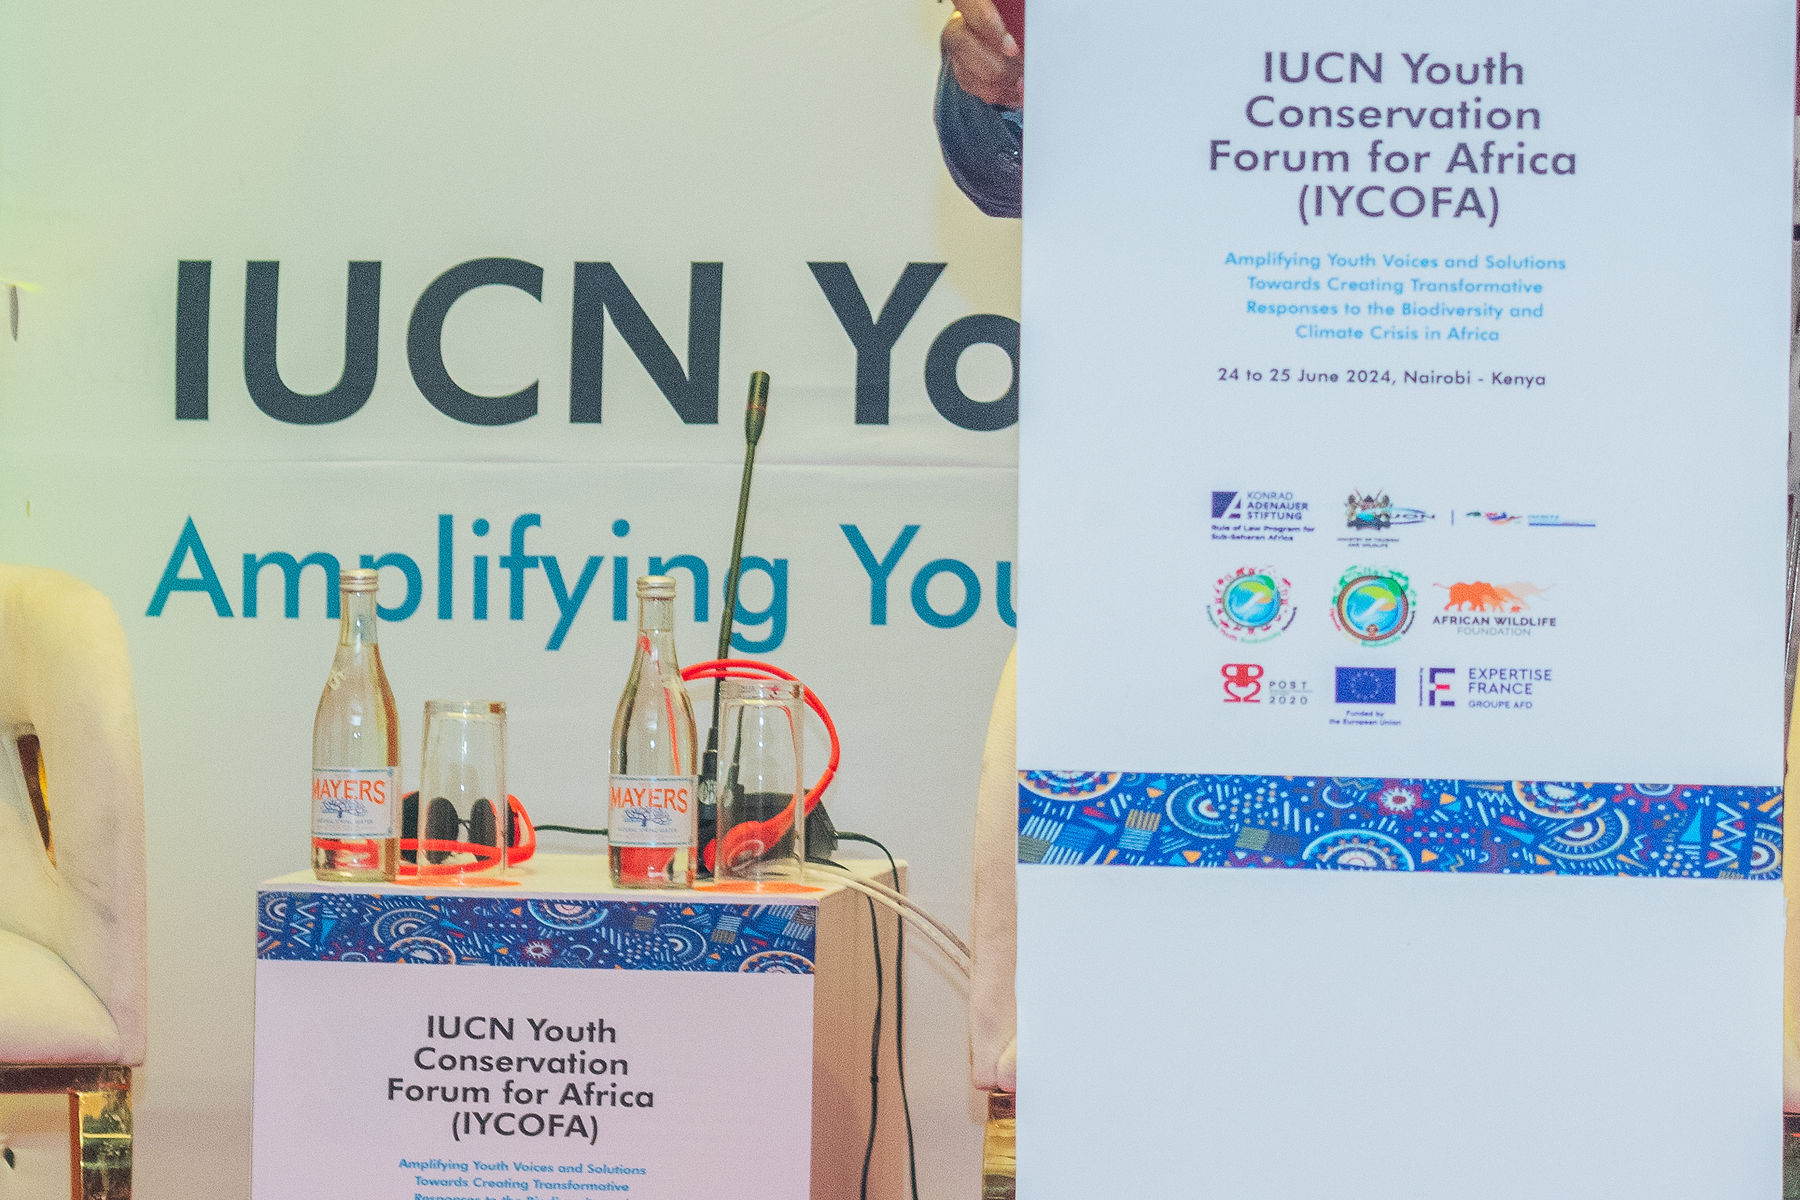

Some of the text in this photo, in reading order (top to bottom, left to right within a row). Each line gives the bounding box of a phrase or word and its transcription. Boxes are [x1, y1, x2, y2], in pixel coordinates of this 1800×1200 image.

[1265, 52, 1523, 85] IUCN Youth
[1246, 95, 1540, 130] Conservation
[1210, 139, 1575, 175] Forum for Africa
[1299, 185, 1498, 228] (IYCOFA)
[1225, 252, 1566, 270] Amplifying Youth Voices and Solutions
[1248, 276, 1543, 295] Towards Creating Transformative
[1247, 300, 1544, 320] Responses to the Biodiversity and
[175, 258, 723, 426] IUCN
[1296, 325, 1499, 341] Climate Crisis in Africa
[1219, 367, 1239, 381] 24
[1246, 370, 1263, 382] to
[1270, 368, 1290, 382] 25
[1298, 369, 1339, 383] June
[1347, 370, 1395, 385] 2024,
[1404, 371, 1470, 384] Nairobi
[1492, 372, 1545, 388] Kenya
[1247, 491, 1294, 501] KONRAD
[1247, 502, 1309, 511] ADENAUER
[1247, 511, 1303, 520] STIFTUNG
[145, 513, 789, 655] Amplifying
[1432, 614, 1558, 628] AFRICAN WILDLIFE
[1456, 625, 1533, 638] FOUNDATION
[1467, 666, 1554, 682] EXPERTISE
[1269, 681, 1309, 690] POST
[1467, 682, 1534, 696] FRANCE
[1269, 696, 1309, 705] 2020
[1467, 700, 1511, 710] GROUPE
[310, 777, 386, 806] MAYERS
[609, 785, 688, 814] MAYERS
[428, 1016, 615, 1043] IUCN Youth
[414, 1047, 628, 1075] Conservation
[388, 1078, 653, 1107] Forum for Africa
[453, 1112, 598, 1145] (IYCOFA)
[398, 1157, 647, 1176] Amplifying Youth Voices and Solutions
[414, 1175, 630, 1192] Towards Creating Transformative
